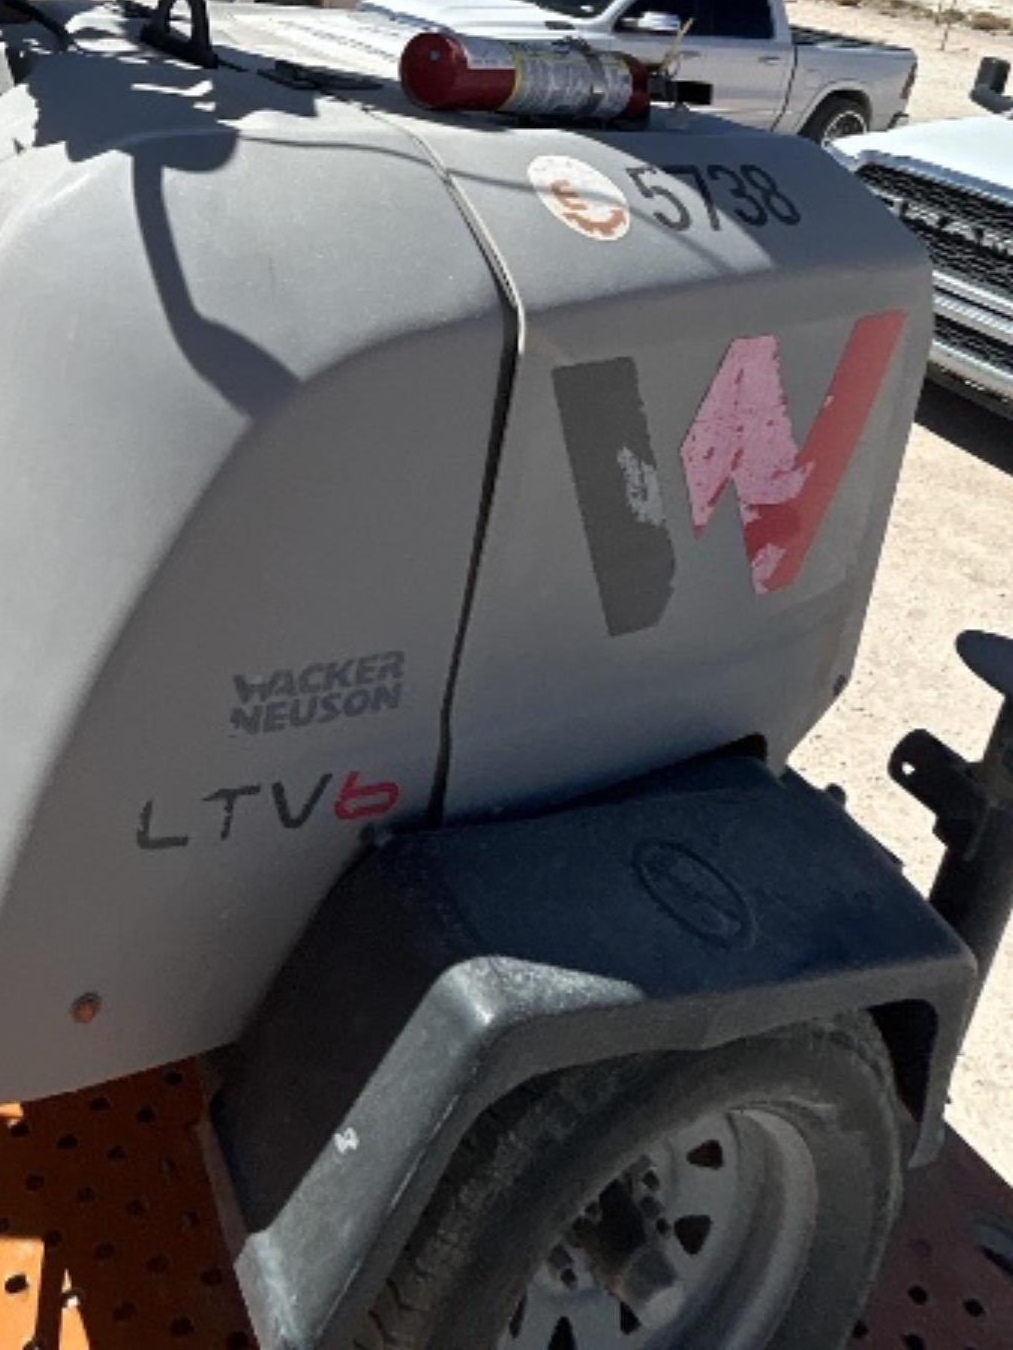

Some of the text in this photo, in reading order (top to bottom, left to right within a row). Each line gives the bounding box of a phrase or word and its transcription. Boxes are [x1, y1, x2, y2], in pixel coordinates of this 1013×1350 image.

[625, 164, 800, 231] 5738
[232, 650, 405, 704] WACKER
[228, 682, 402, 737] NEUSON
